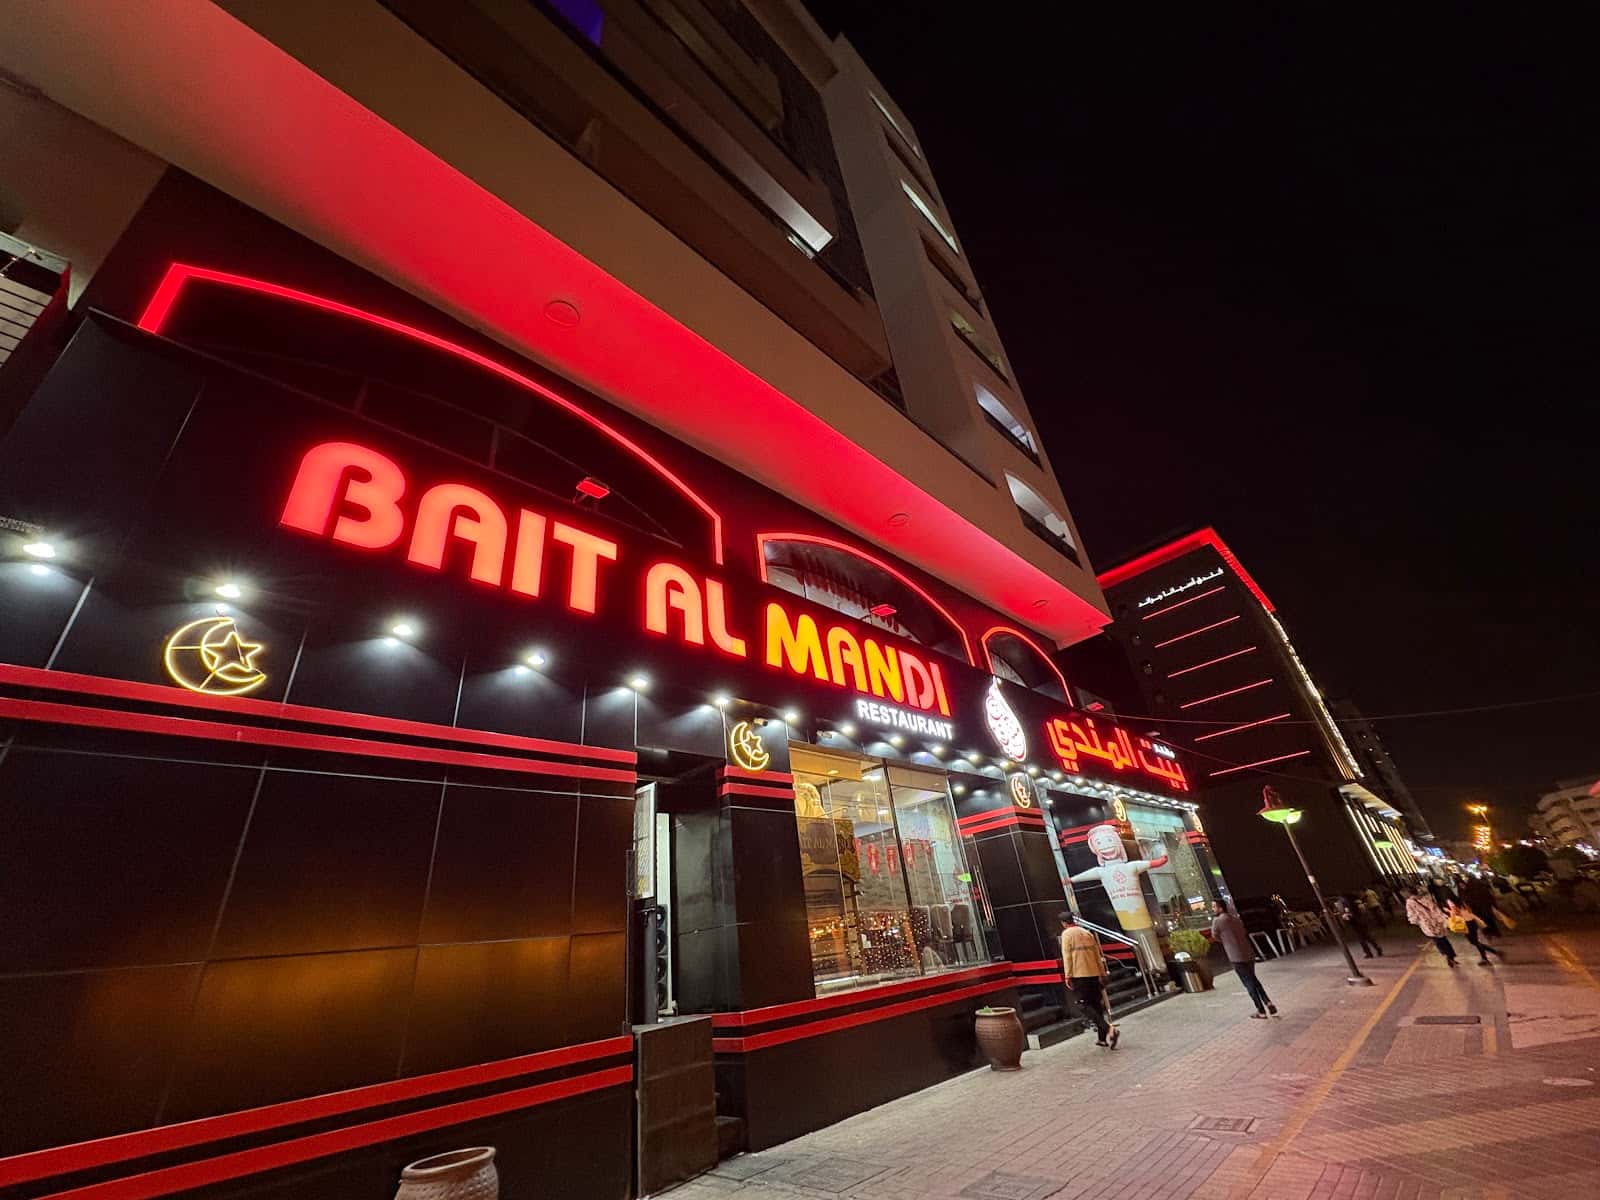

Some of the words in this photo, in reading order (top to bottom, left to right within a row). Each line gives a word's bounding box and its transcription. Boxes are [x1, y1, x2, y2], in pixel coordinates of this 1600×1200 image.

[280, 441, 618, 614] BAIT
[645, 562, 747, 657] AL
[765, 602, 951, 717] MANDI
[856, 698, 953, 741] RESTAURANT
[1046, 717, 1139, 773] المندي
[1137, 738, 1190, 792] بيت
